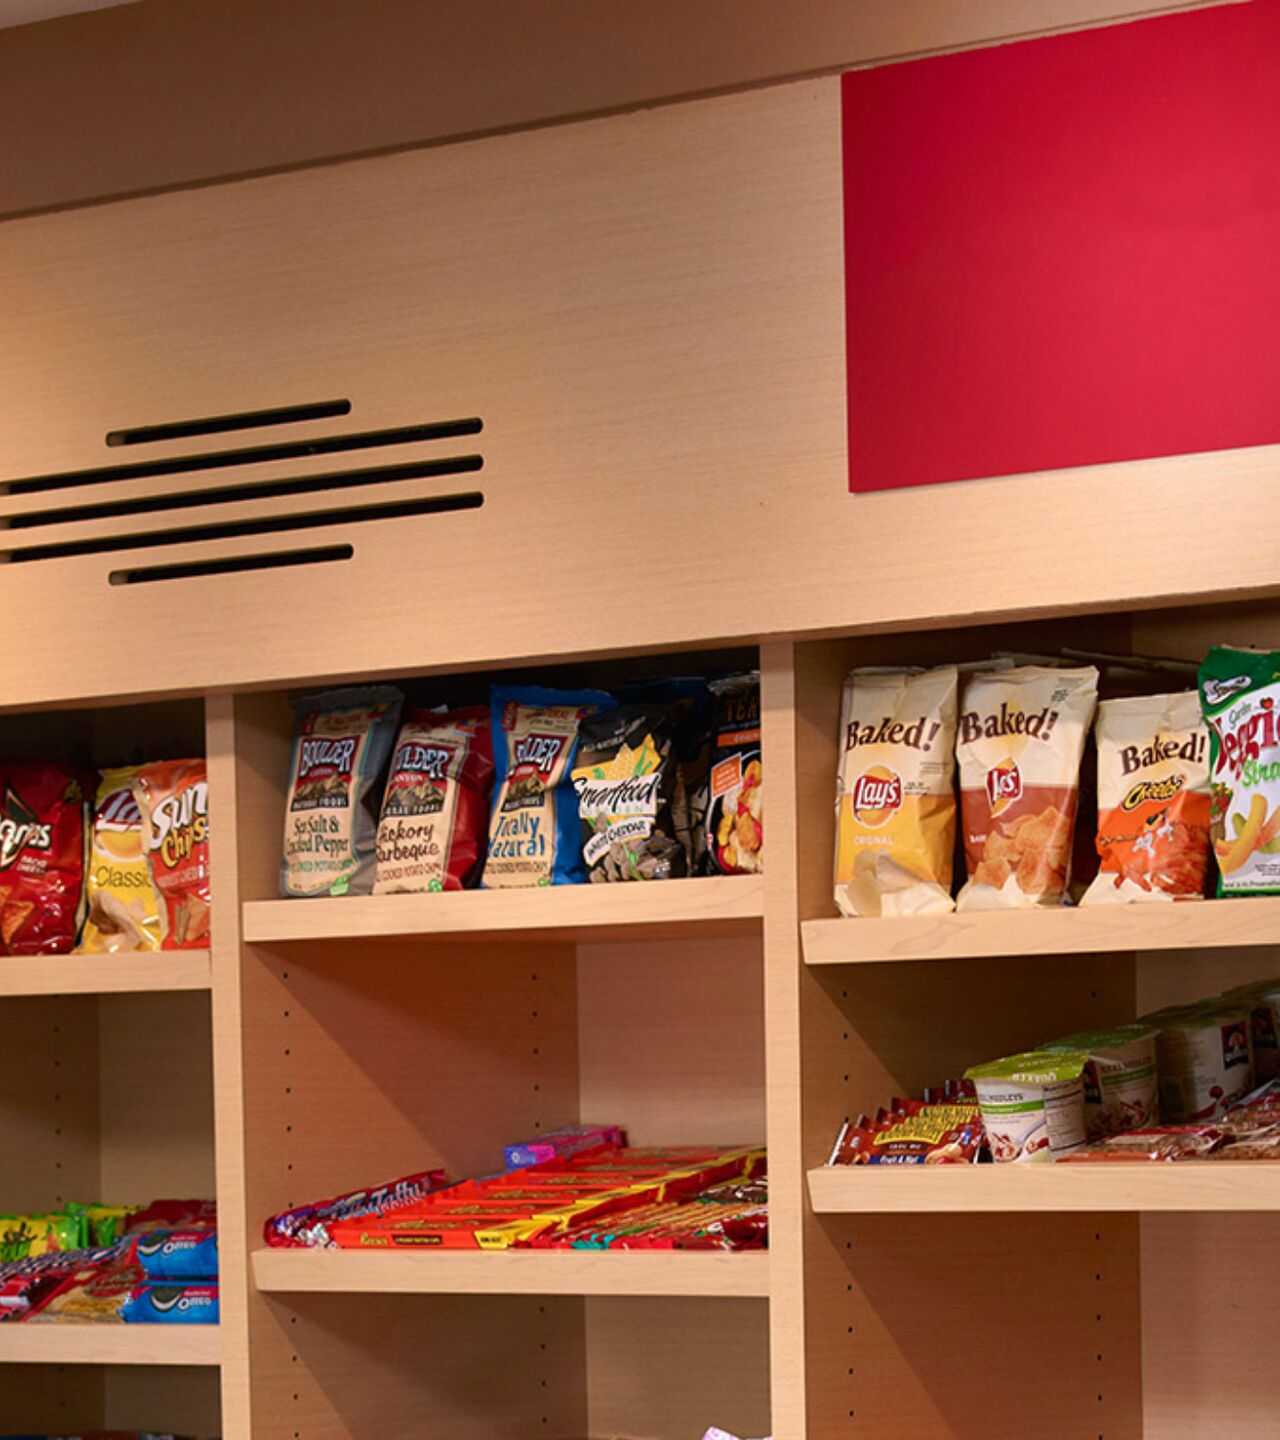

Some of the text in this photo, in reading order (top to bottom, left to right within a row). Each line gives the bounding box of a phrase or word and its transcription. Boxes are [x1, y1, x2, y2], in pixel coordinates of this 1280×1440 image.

[846, 717, 941, 751] Baked!
[960, 702, 1059, 745] Baked!
[1121, 732, 1206, 775] Baked!
[855, 775, 900, 810] Lay's
[151, 782, 208, 848] Sun
